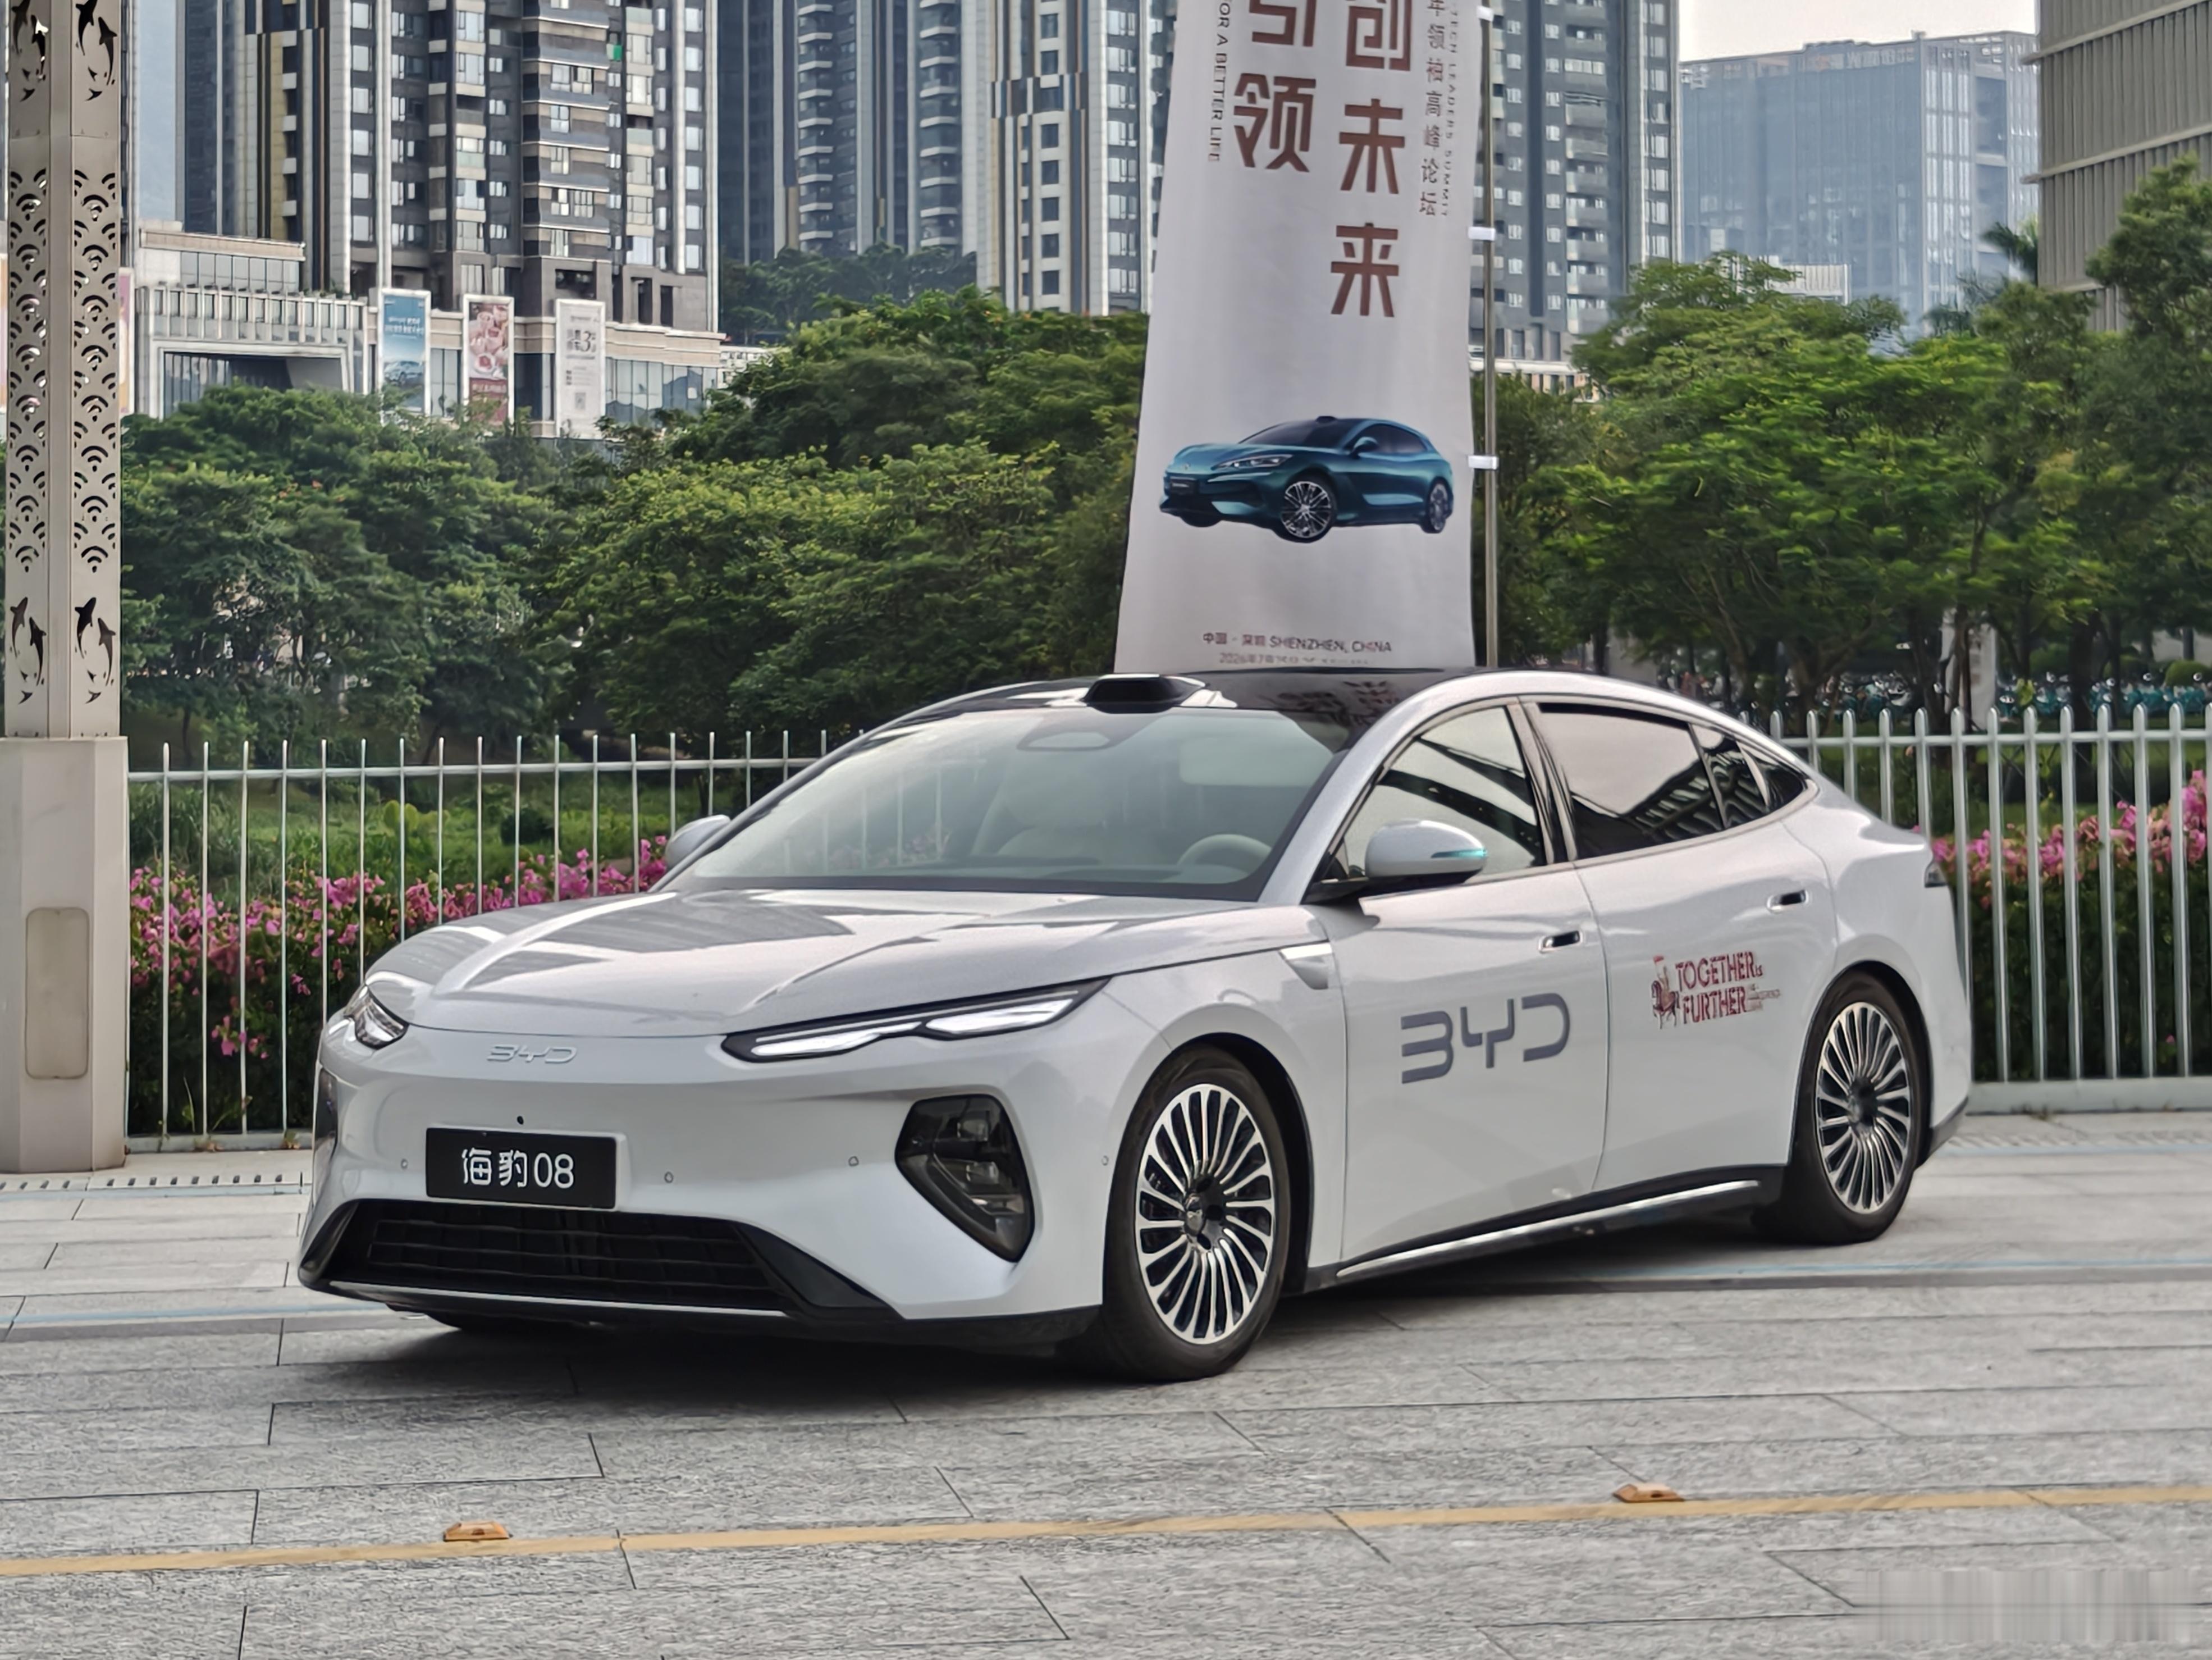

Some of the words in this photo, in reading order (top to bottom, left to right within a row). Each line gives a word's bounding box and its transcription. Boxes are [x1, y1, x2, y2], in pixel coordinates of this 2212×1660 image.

[1217, 0, 1231, 28] OR
[1217, 33, 1228, 45] A
[1212, 53, 1227, 120] BETTER
[1675, 951, 1756, 992] TOGETHER
[1683, 986, 1747, 1025] FURTHER
[486, 1043, 577, 1065] BYD
[1400, 992, 1570, 1084] BYD
[461, 1147, 575, 1189] 海豹08
